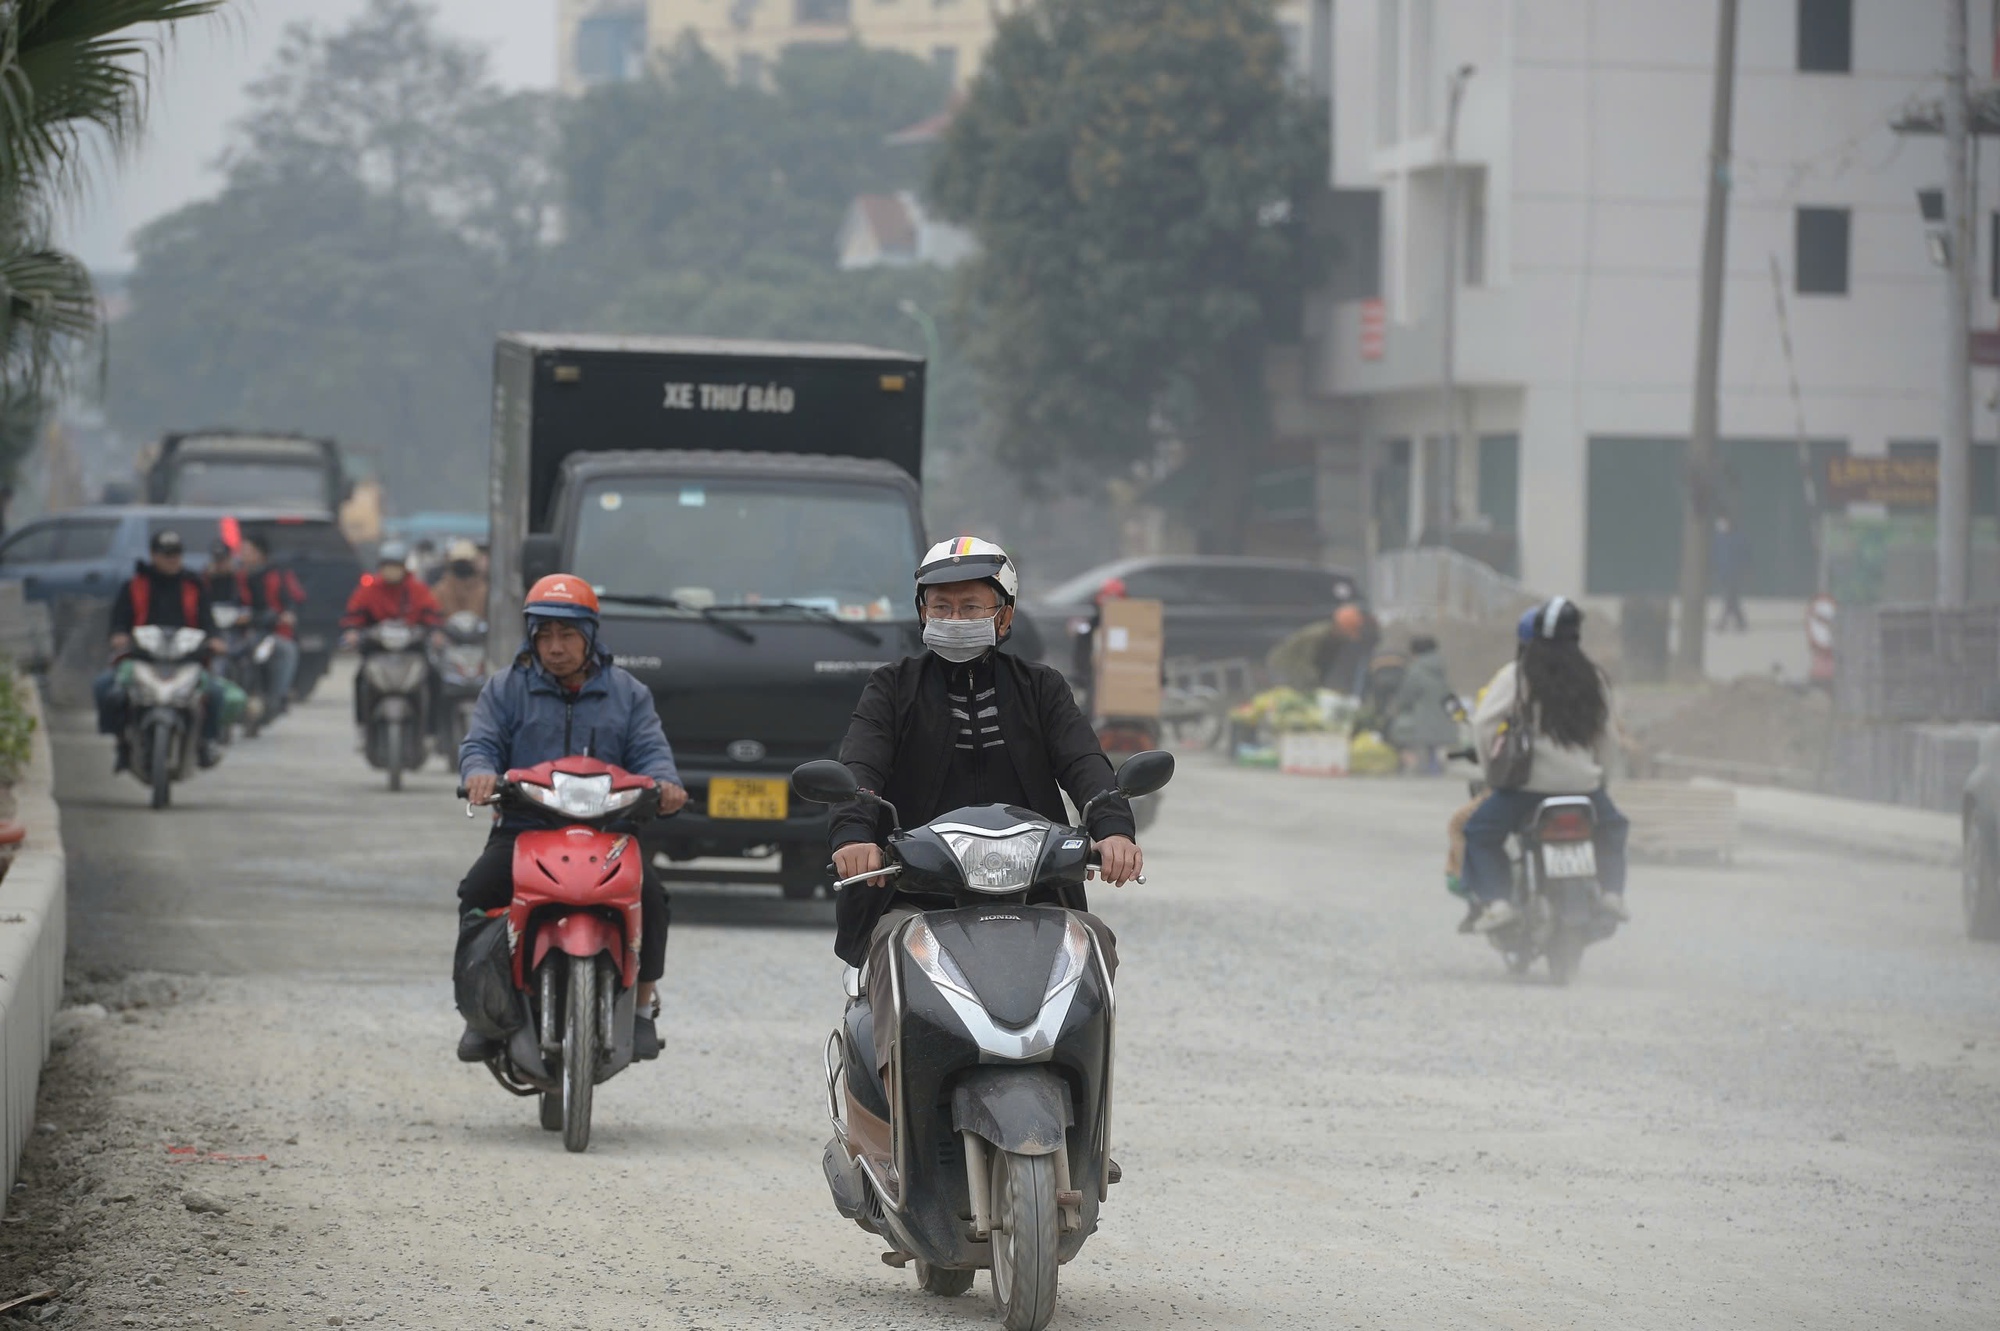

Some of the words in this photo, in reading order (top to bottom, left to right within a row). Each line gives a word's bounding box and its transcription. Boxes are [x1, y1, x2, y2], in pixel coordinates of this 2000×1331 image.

[663, 382, 694, 409] XE
[699, 382, 747, 411] THƯ
[747, 381, 795, 413] BÁO
